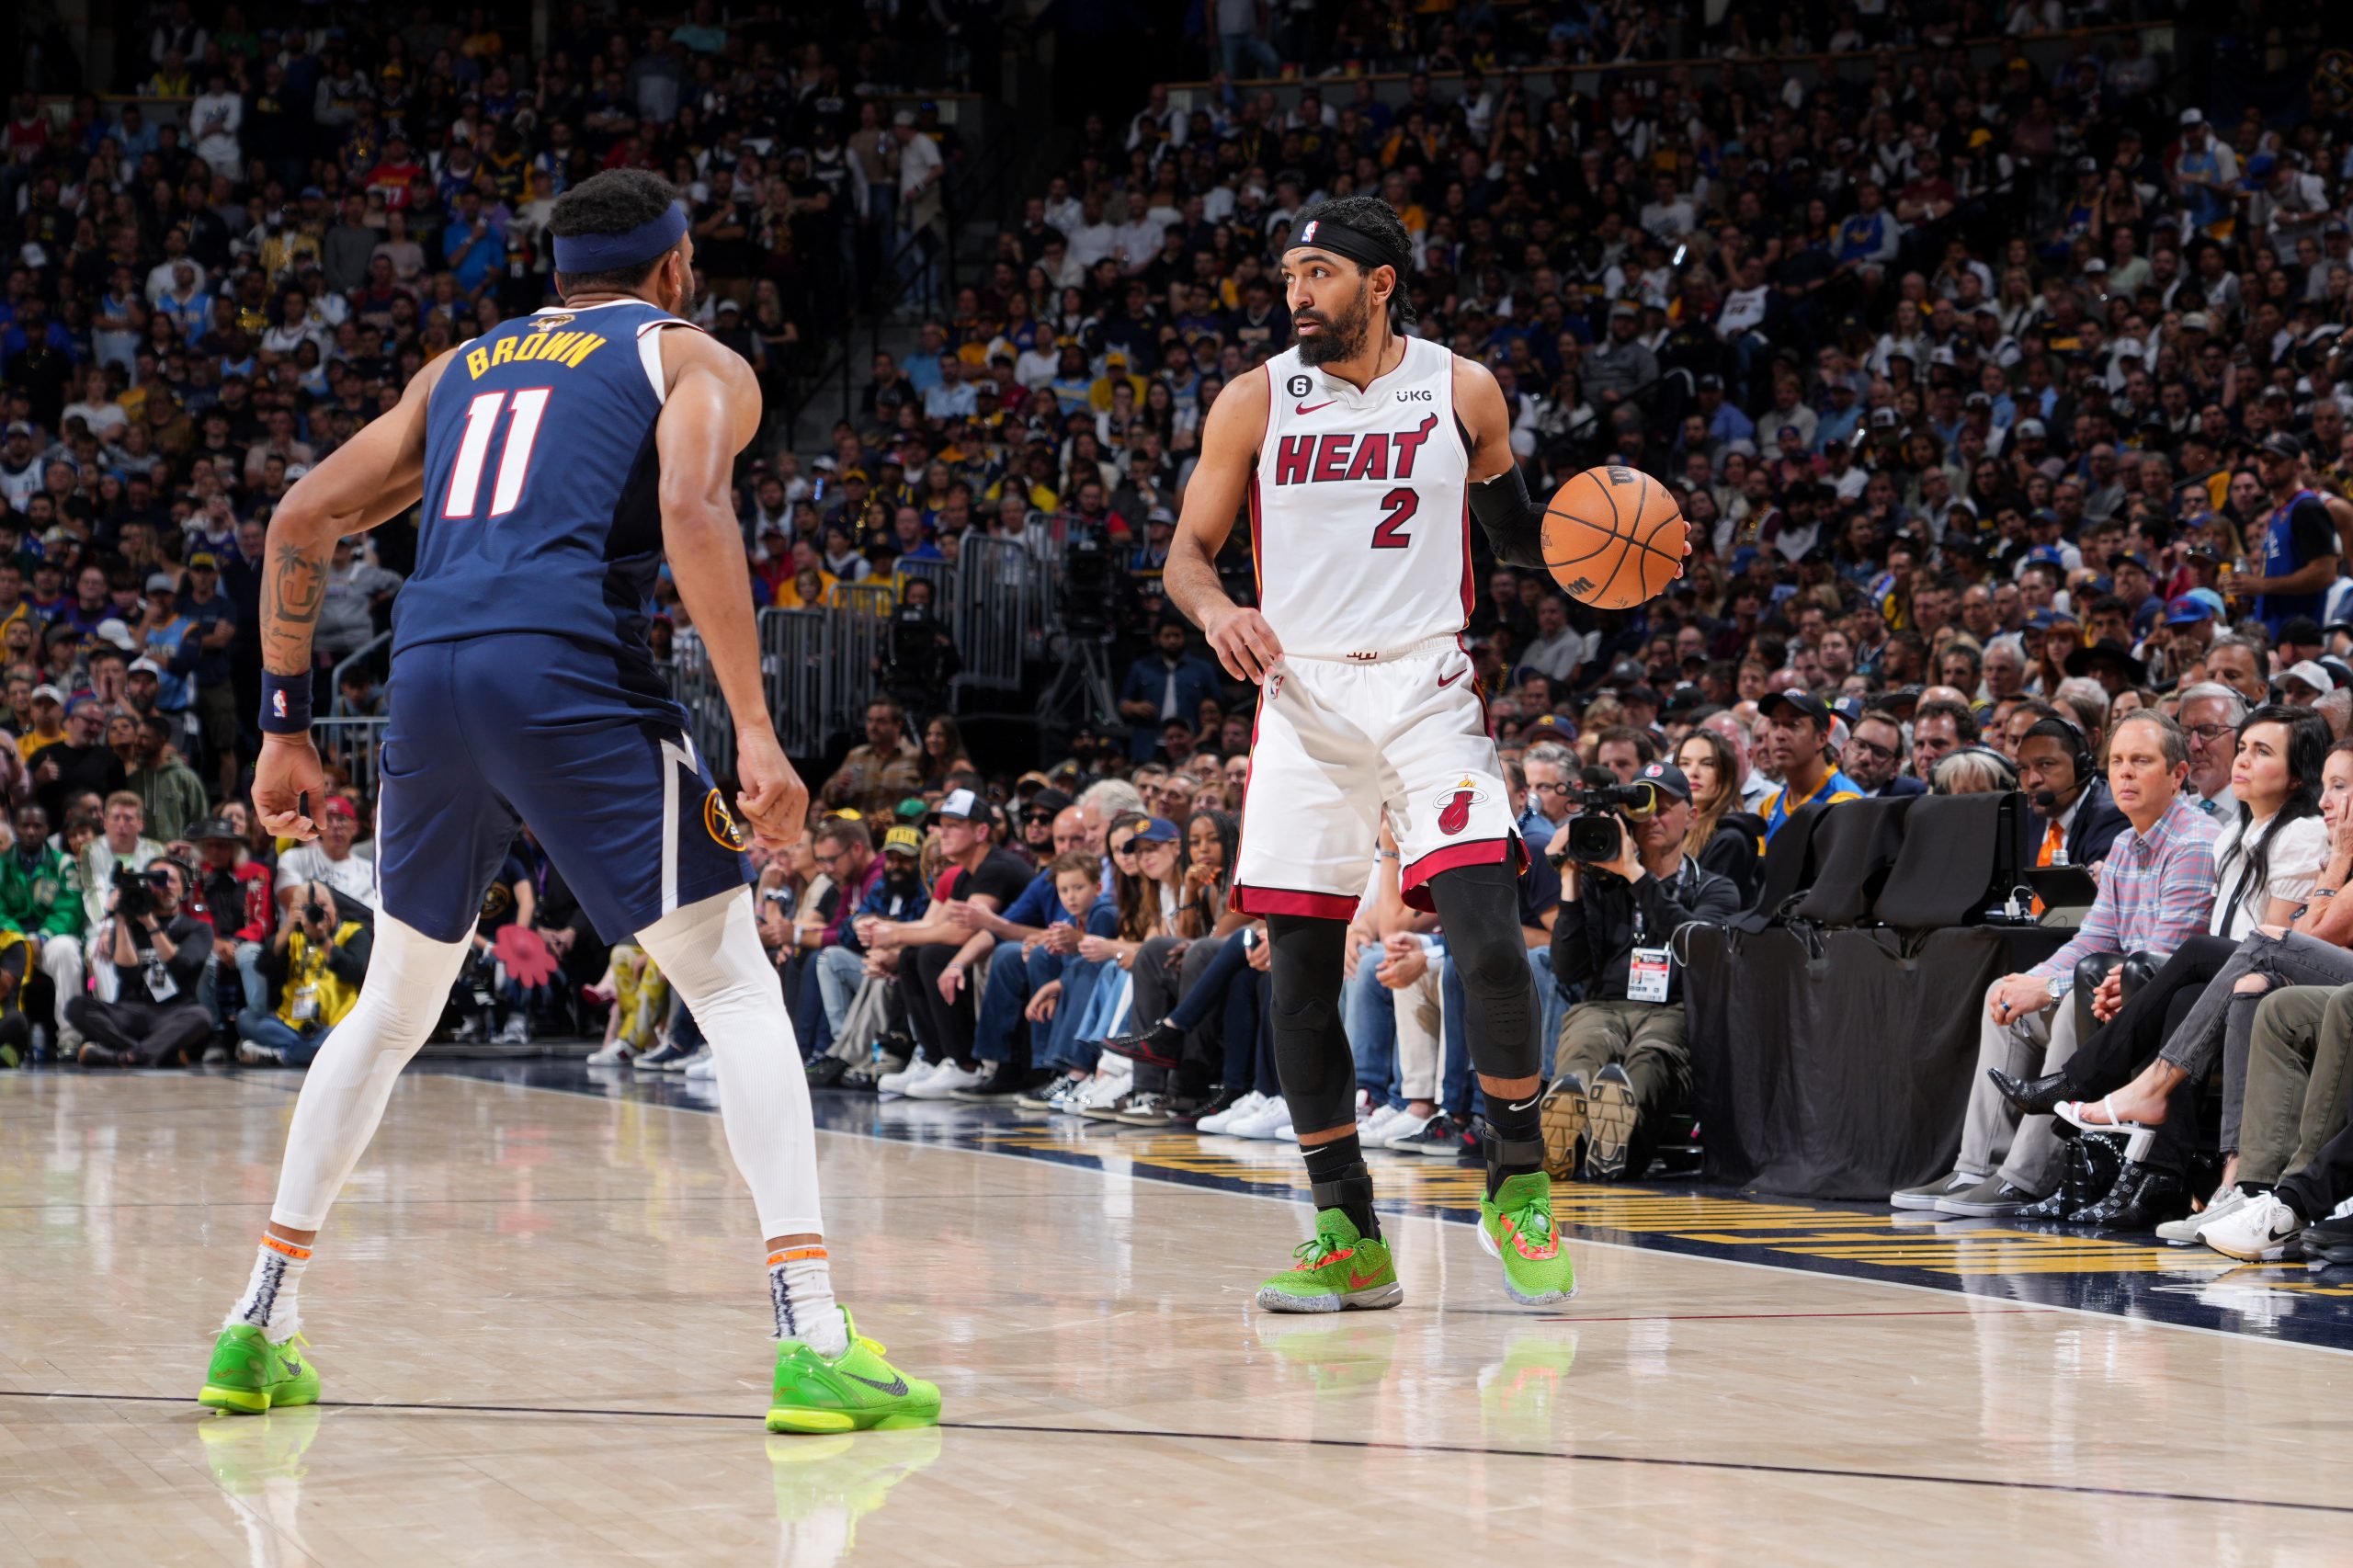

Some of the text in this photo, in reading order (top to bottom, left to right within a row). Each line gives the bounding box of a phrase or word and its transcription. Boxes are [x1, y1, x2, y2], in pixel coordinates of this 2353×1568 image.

[466, 332, 607, 381] BROWN
[1292, 377, 1307, 395] 6
[442, 386, 553, 519] 11
[1276, 412, 1438, 485] HEAT
[1370, 487, 1419, 549] 2
